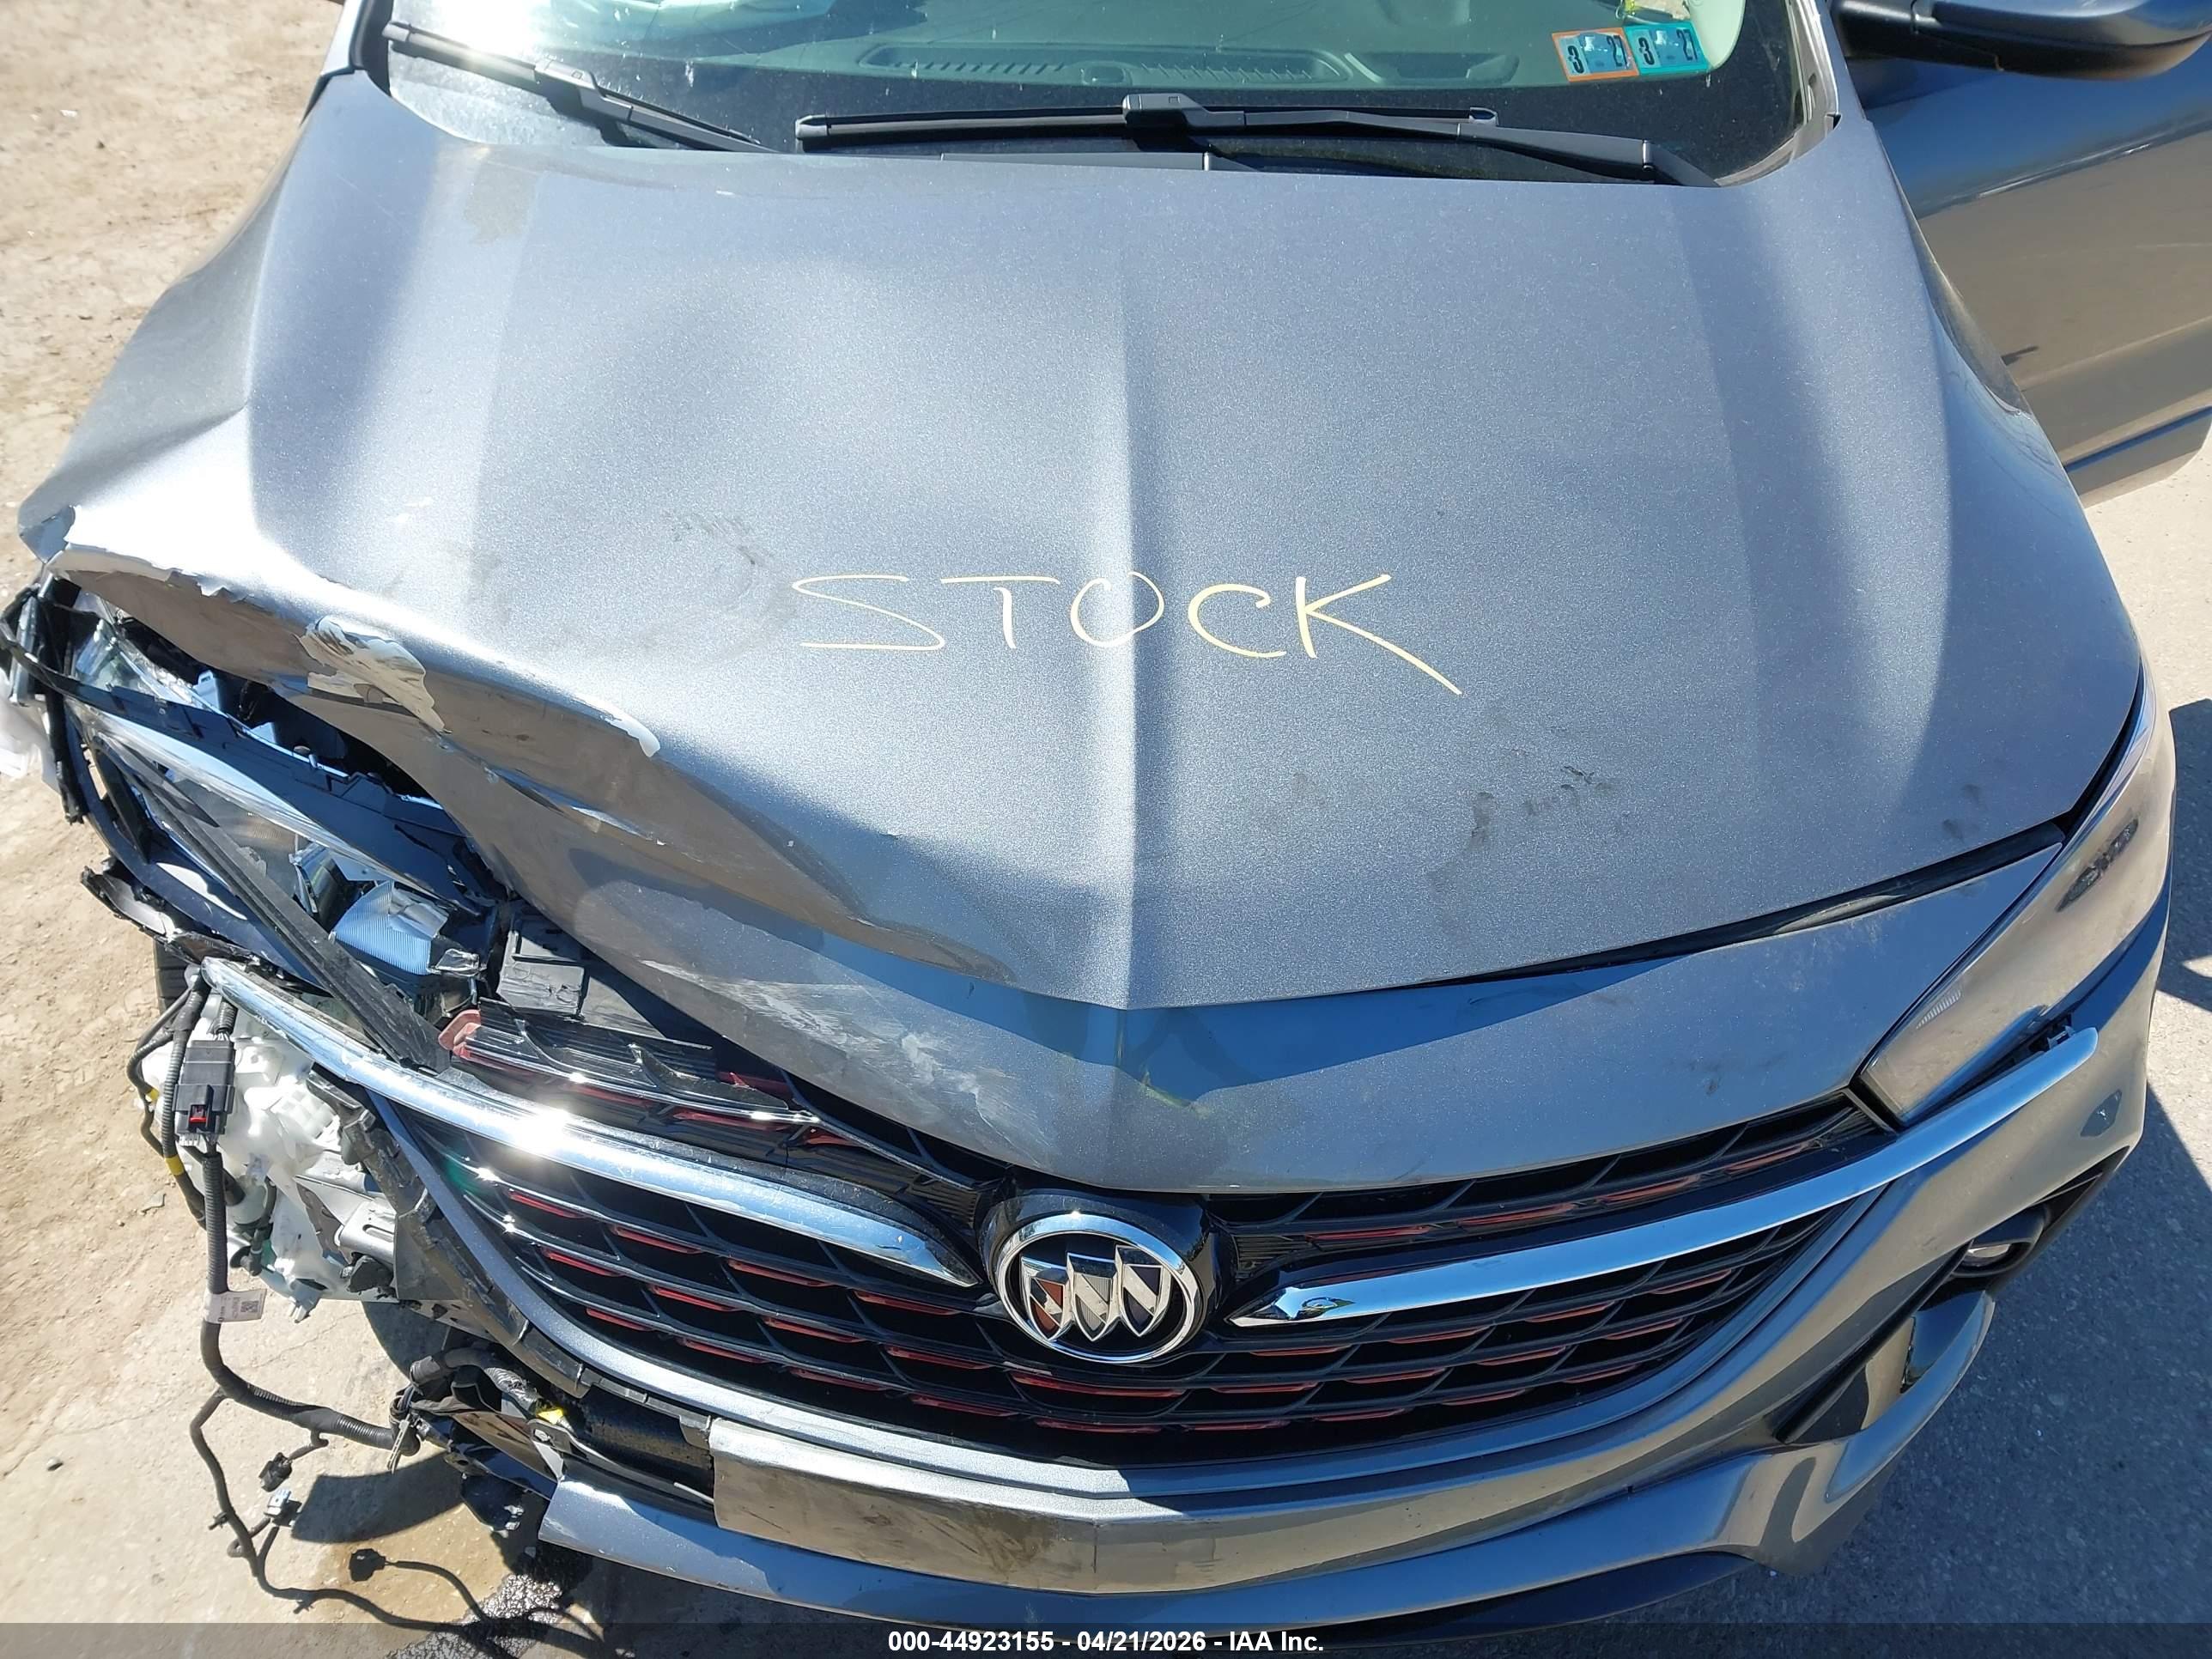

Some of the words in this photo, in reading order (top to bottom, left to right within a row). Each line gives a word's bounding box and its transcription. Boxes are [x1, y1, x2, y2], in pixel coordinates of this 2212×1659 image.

[1567, 46, 1585, 74] 3
[1606, 34, 1628, 69] 27
[1638, 37, 1655, 65] 3
[1676, 28, 1698, 62] 27
[792, 571, 1462, 696] STOCK
